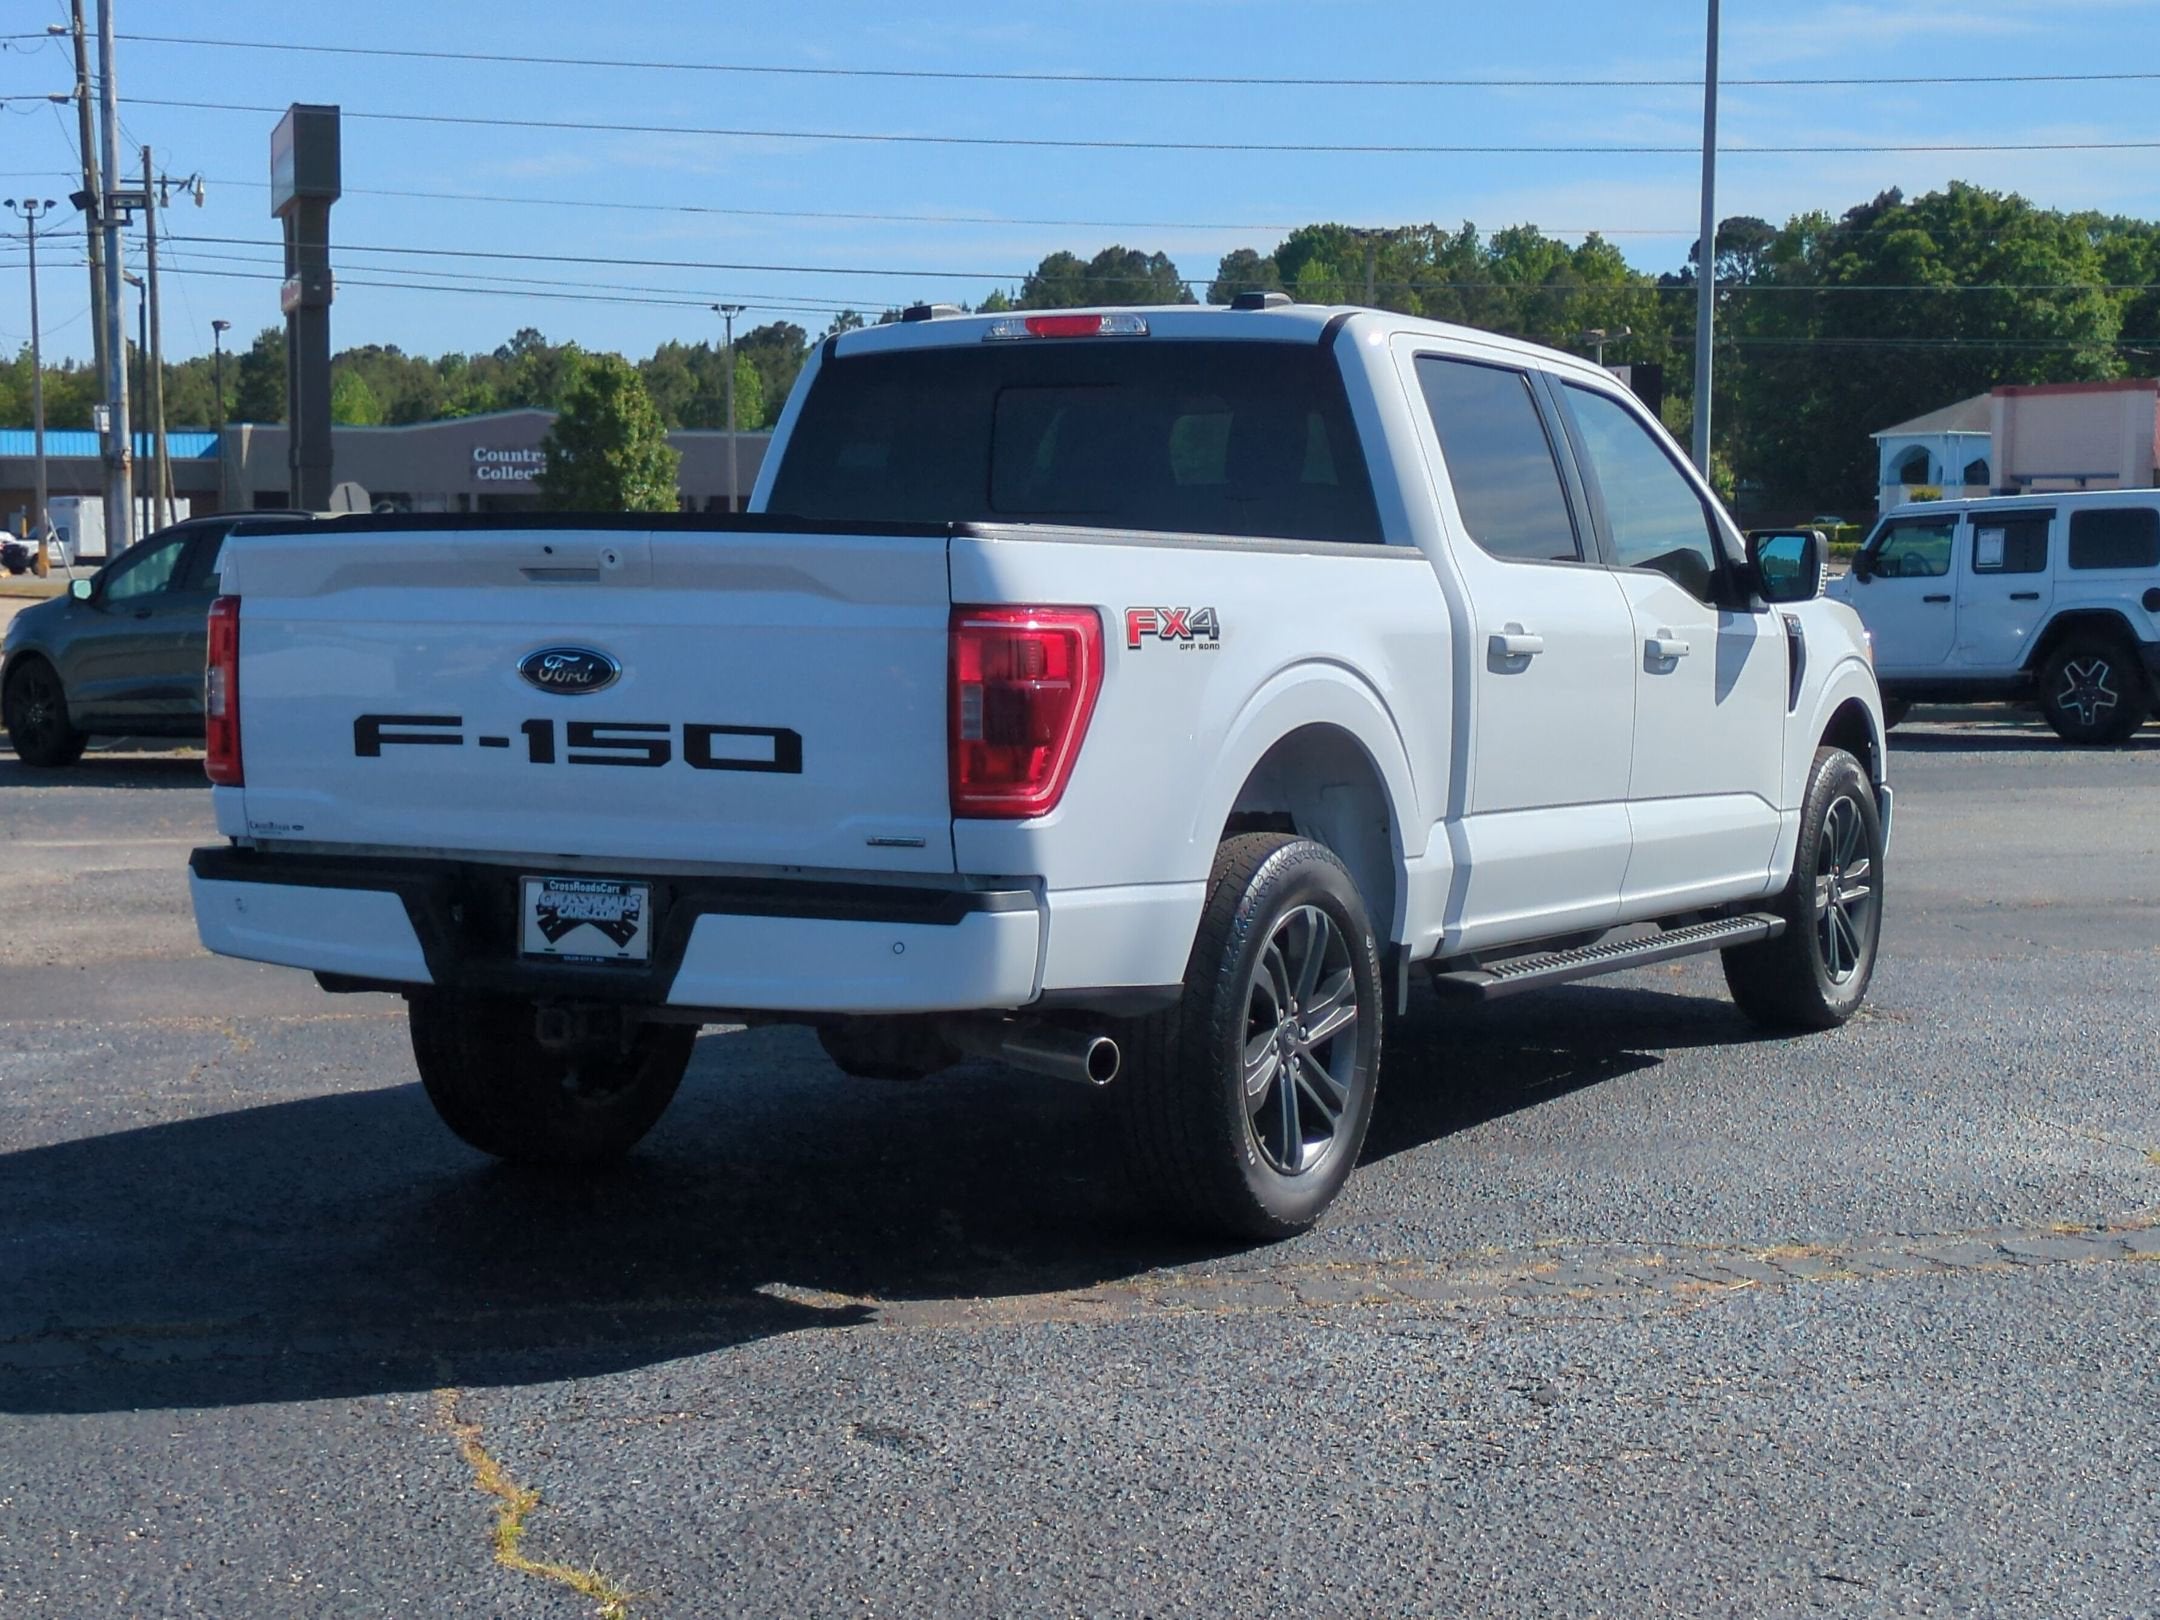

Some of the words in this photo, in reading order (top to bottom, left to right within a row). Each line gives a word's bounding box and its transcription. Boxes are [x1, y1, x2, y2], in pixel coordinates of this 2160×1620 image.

[1125, 607, 1220, 650] FX4
[538, 654, 593, 683] Ford
[353, 714, 803, 774] F-150
